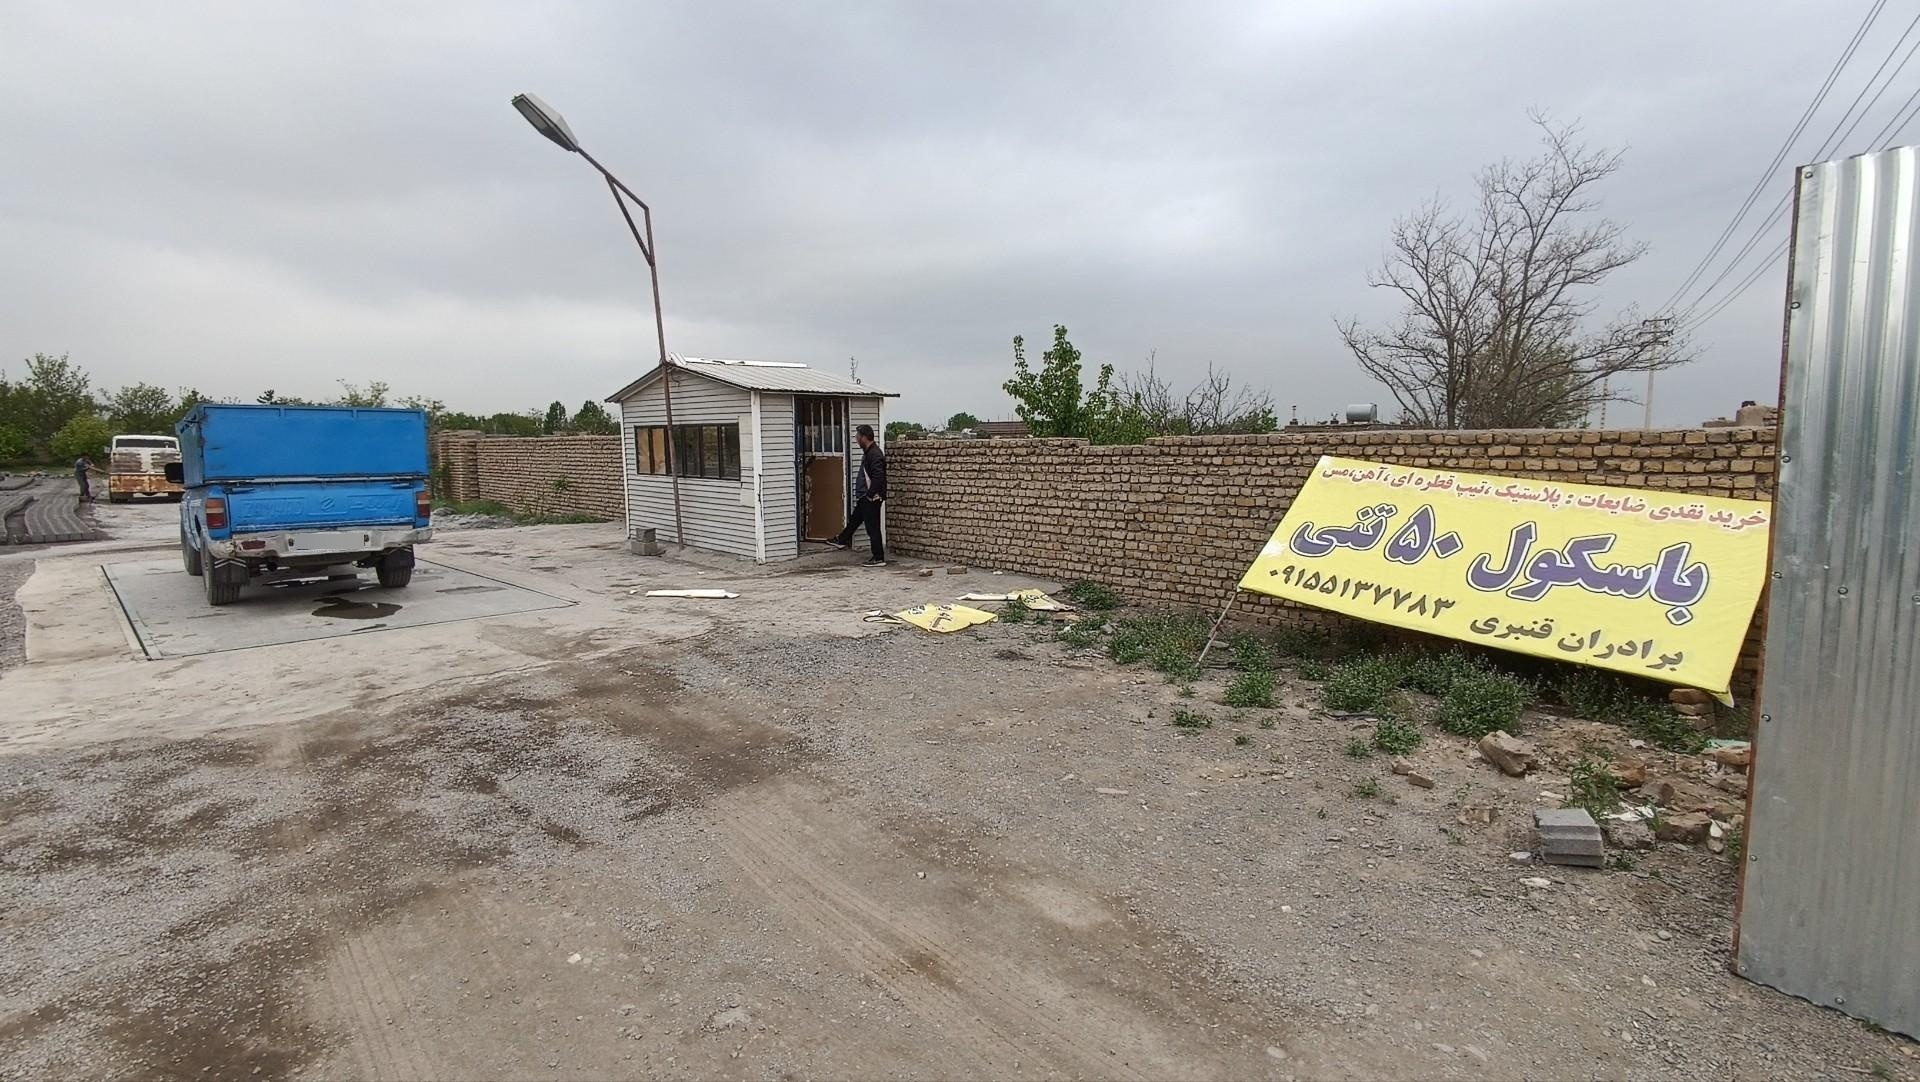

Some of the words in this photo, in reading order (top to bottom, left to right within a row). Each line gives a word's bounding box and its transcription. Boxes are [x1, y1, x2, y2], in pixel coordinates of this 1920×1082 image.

[1495, 484, 1561, 508] پلاستیک
[1577, 494, 1646, 514] ضایعات
[1650, 504, 1704, 522] نقدی
[1709, 508, 1767, 530] خرید
[1289, 502, 1398, 558] تنی
[1383, 503, 1463, 564] ۵۰
[1466, 520, 1710, 626] باسکول
[1270, 564, 1456, 620] ۰۹۱۵۵۱۳۷۷۸۳
[1469, 617, 1555, 641] قنبری
[1557, 629, 1684, 672] برادران
